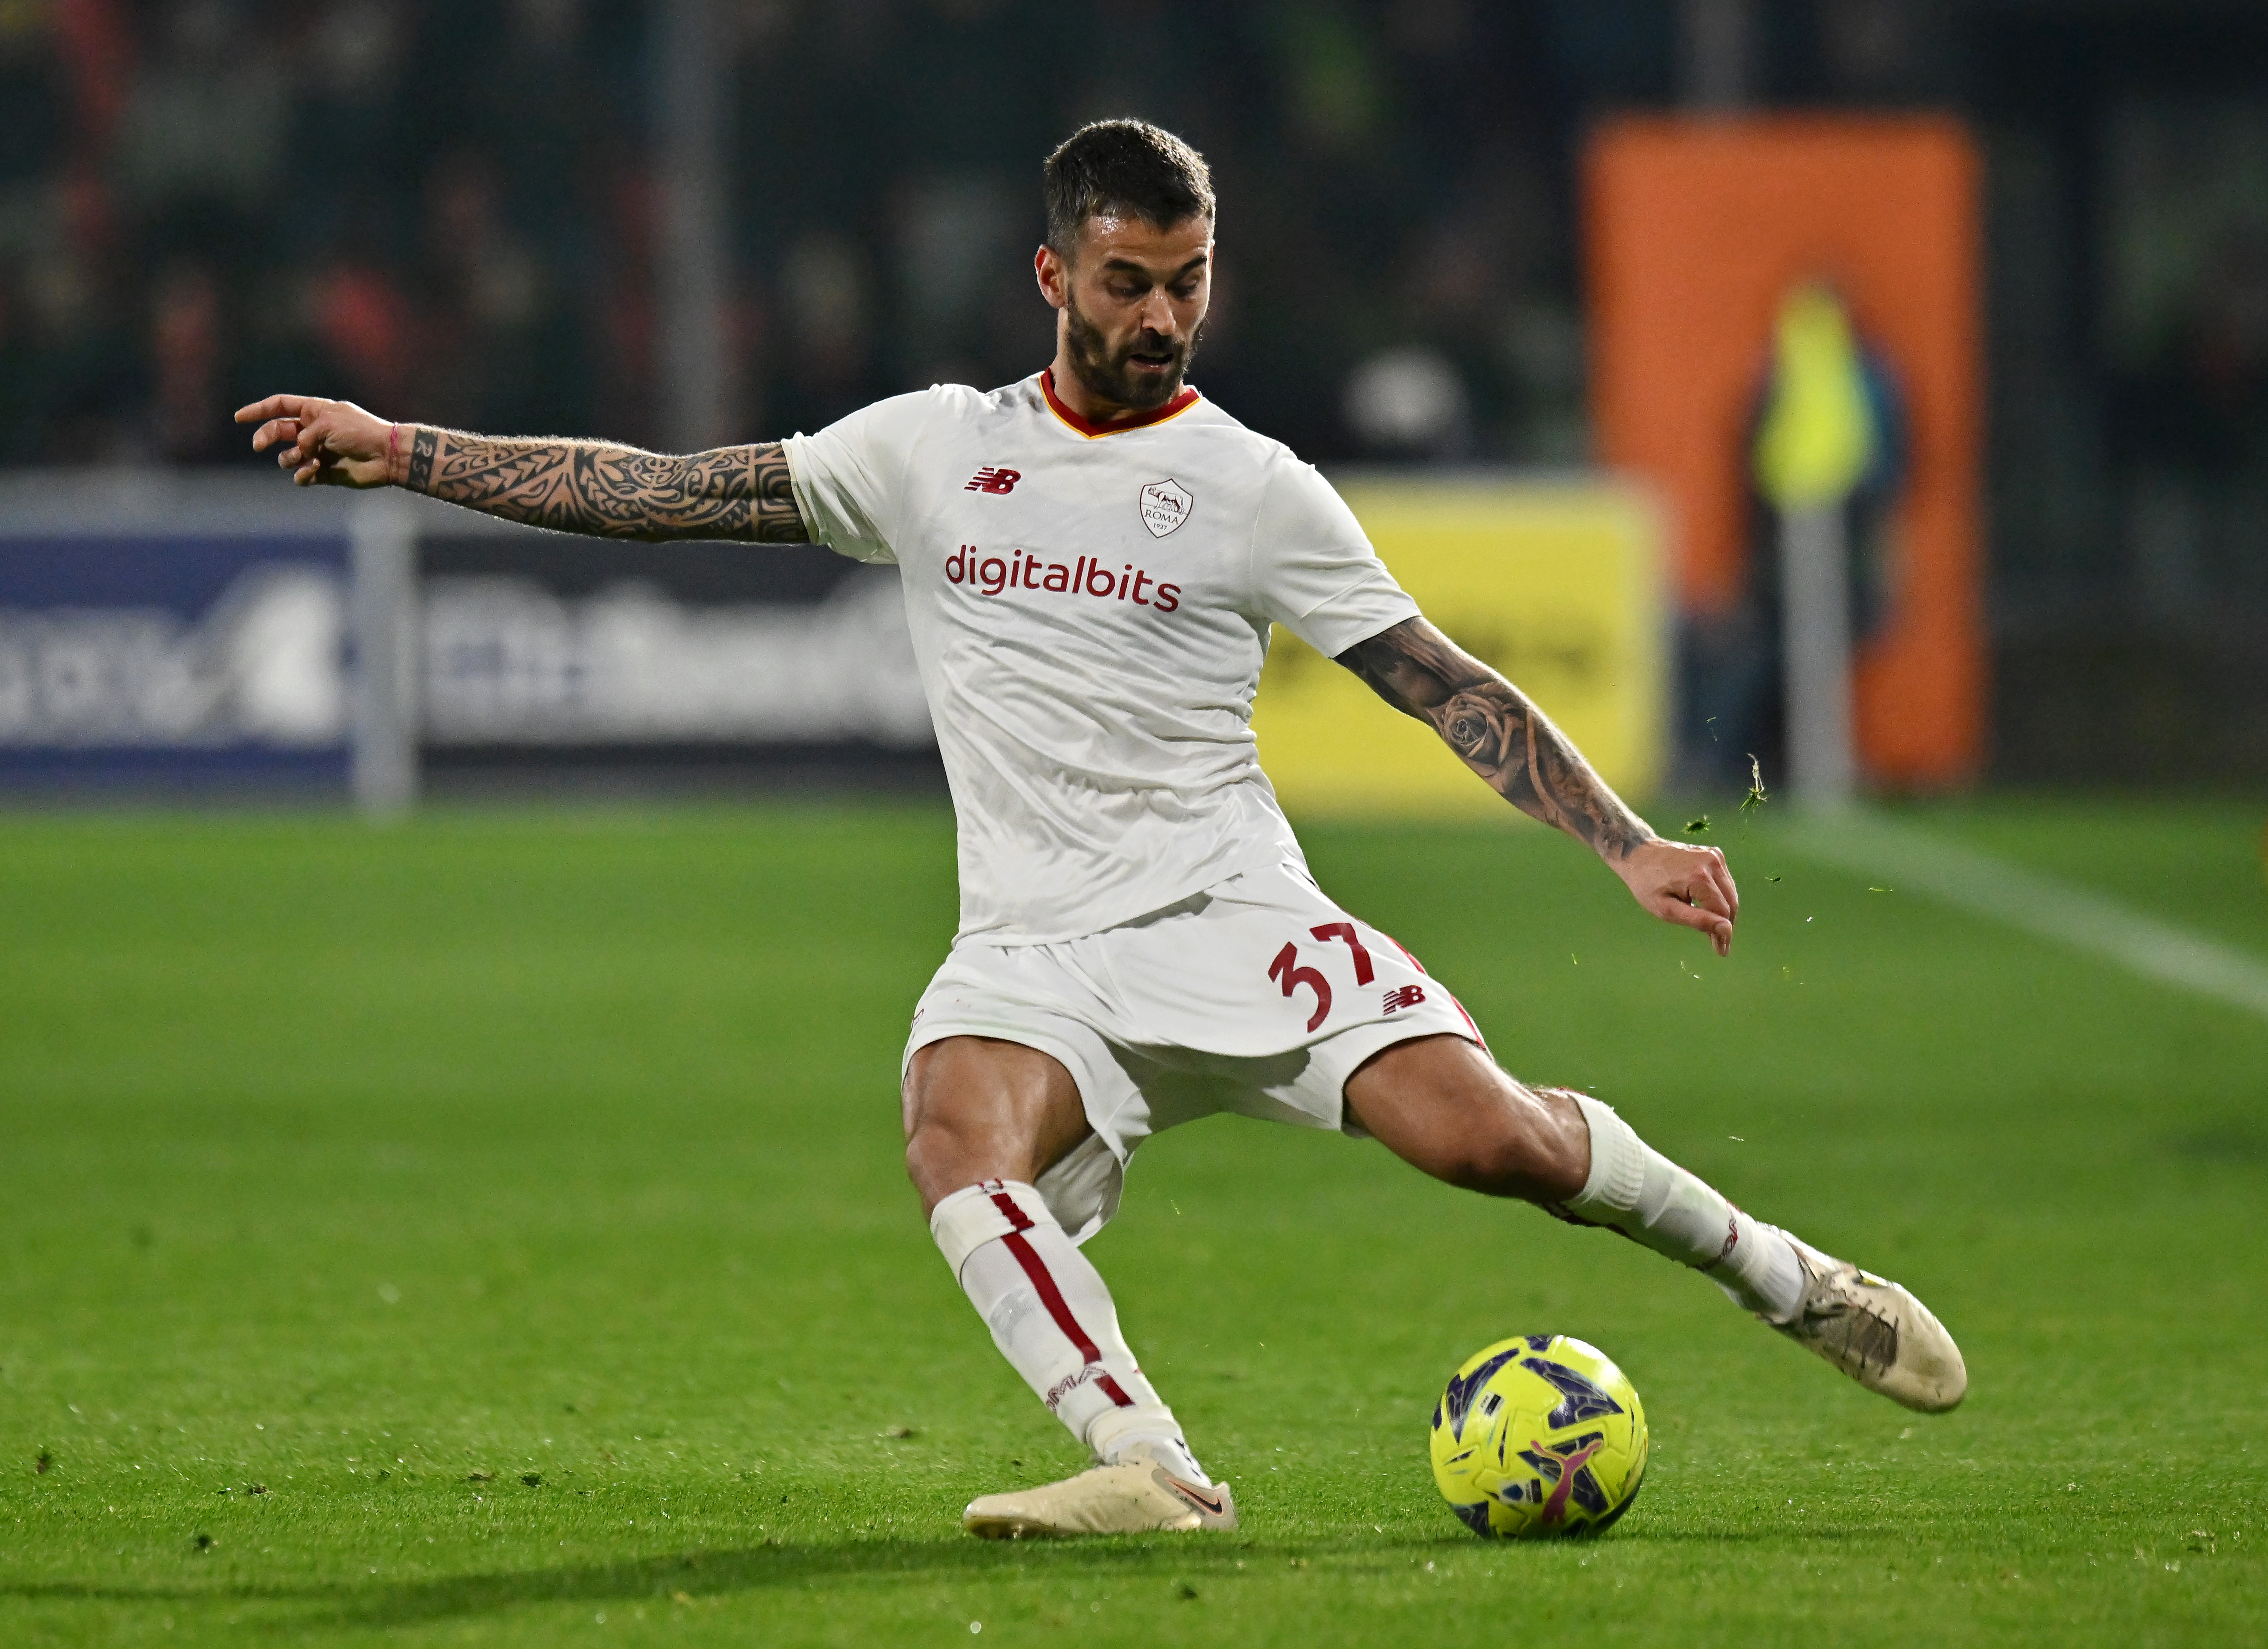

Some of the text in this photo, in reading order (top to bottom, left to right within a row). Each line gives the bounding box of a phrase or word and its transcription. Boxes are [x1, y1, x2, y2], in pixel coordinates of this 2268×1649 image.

[1145, 510, 1179, 525] ROMA
[946, 544, 1182, 613] digitalbits
[1268, 922, 1375, 1034] 37
